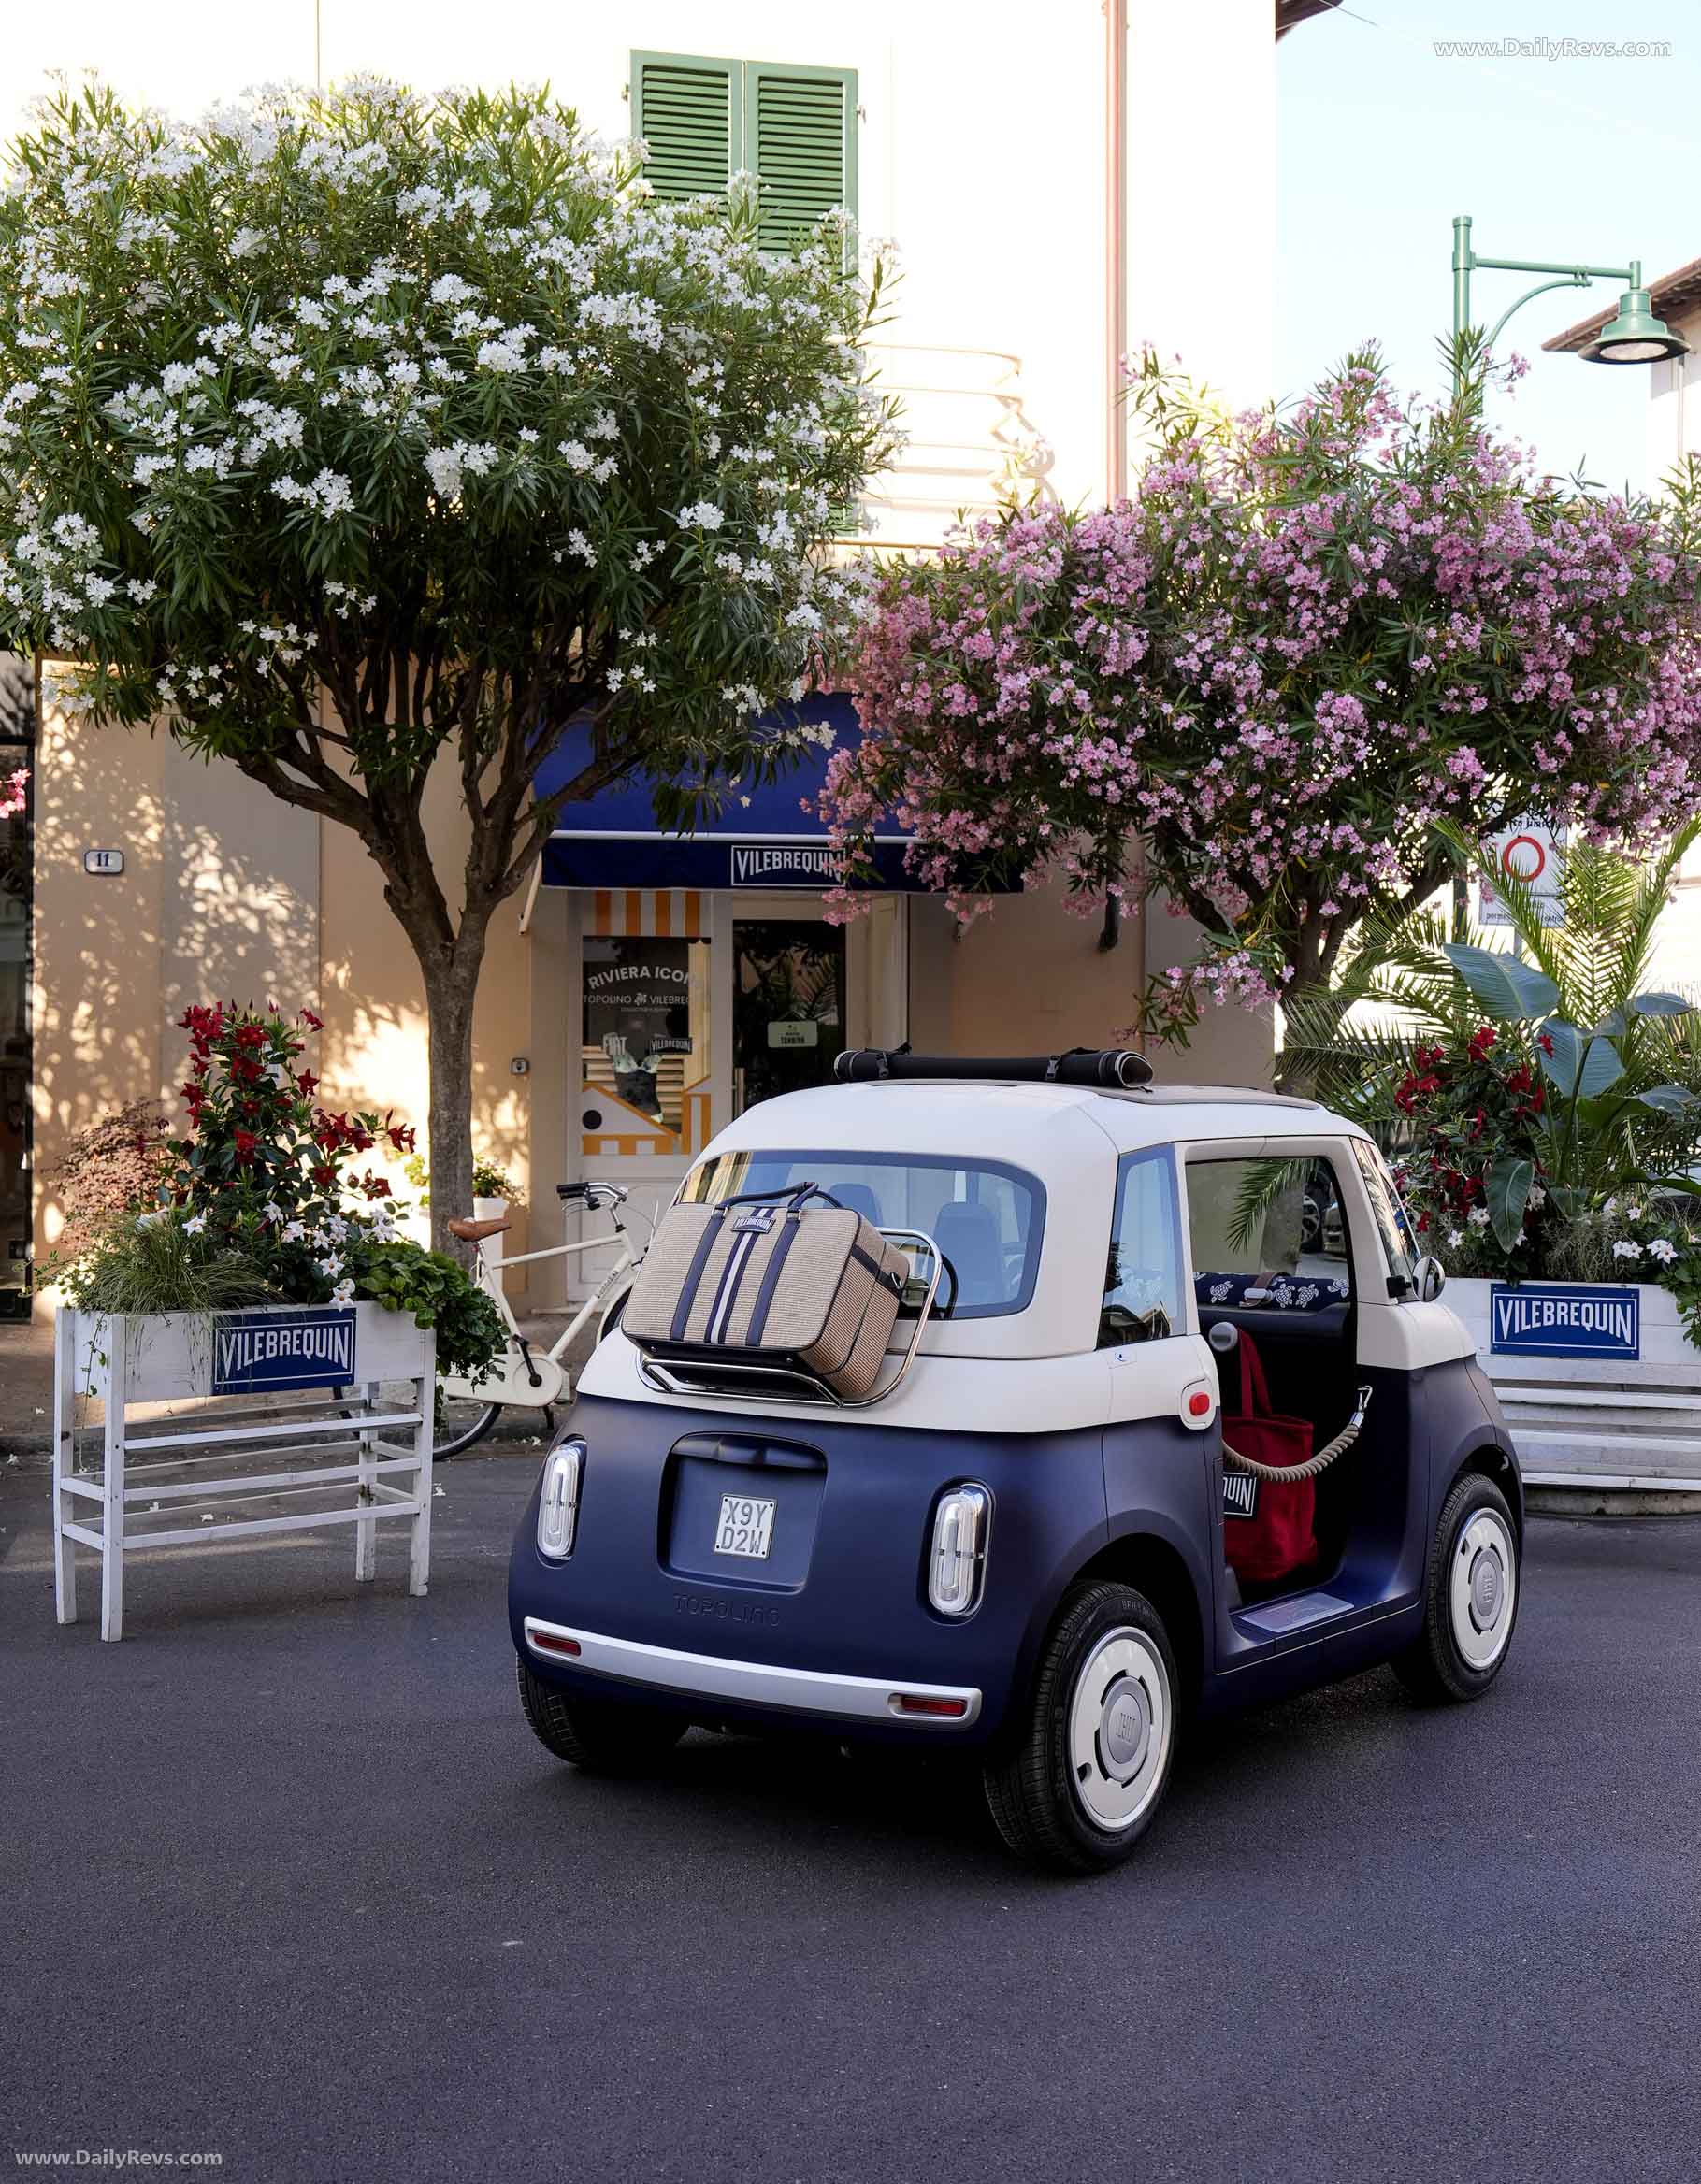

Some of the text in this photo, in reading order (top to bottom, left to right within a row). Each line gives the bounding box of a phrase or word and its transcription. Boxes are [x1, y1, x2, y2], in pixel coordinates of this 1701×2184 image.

[97, 853, 108, 867] 11
[736, 850, 842, 882] VILEBREQUIN
[587, 966, 651, 990] RIVIERA
[1498, 1300, 1631, 1345] VILEBREQUIN
[221, 1326, 350, 1379] VILEBREQUIN
[726, 1500, 767, 1527] X9Y
[721, 1526, 763, 1554] D2W
